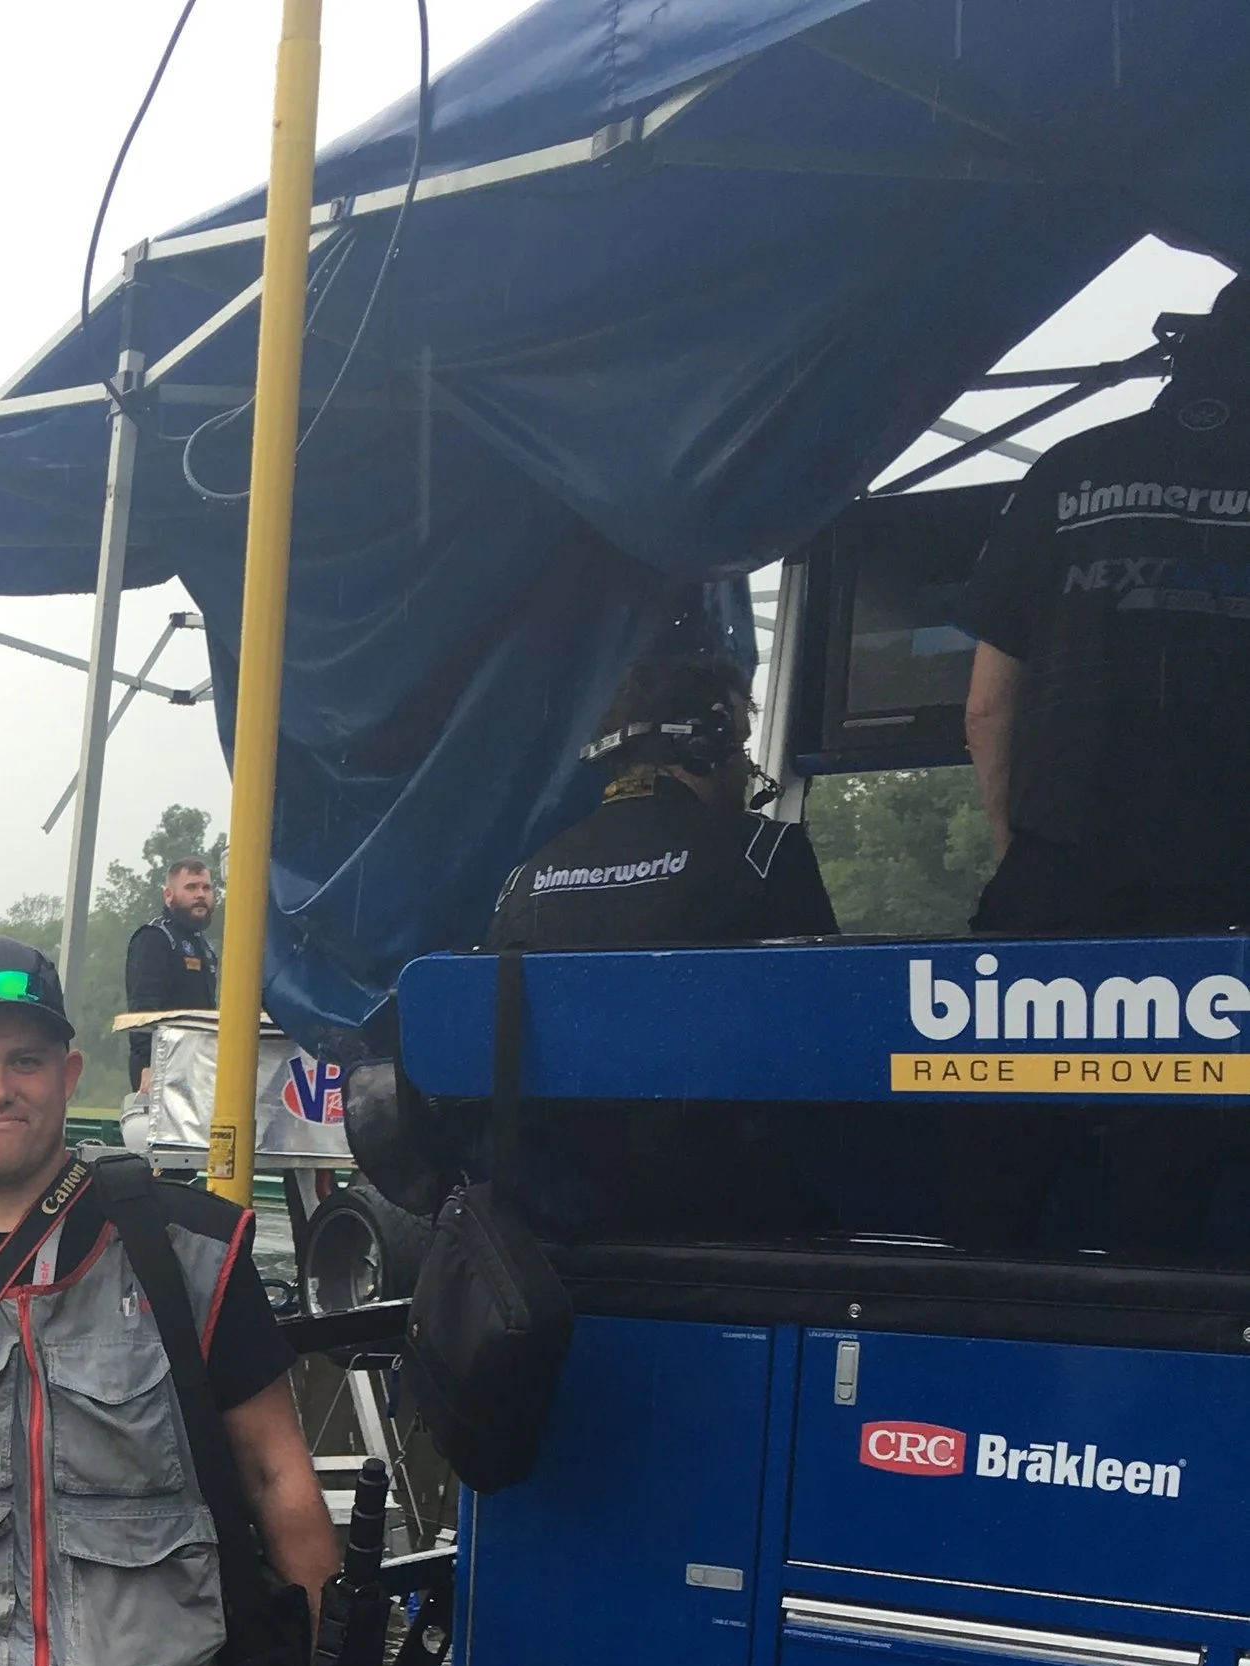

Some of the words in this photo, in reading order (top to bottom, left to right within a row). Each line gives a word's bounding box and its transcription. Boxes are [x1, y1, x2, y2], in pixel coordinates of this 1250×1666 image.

[1057, 479, 1250, 520] bimmerw
[533, 850, 689, 890] bimmerworld
[913, 1060, 1015, 1082] RACE
[1053, 1060, 1224, 1083] PROVEN
[41, 1163, 87, 1215] Canon
[867, 1429, 955, 1467] CRC
